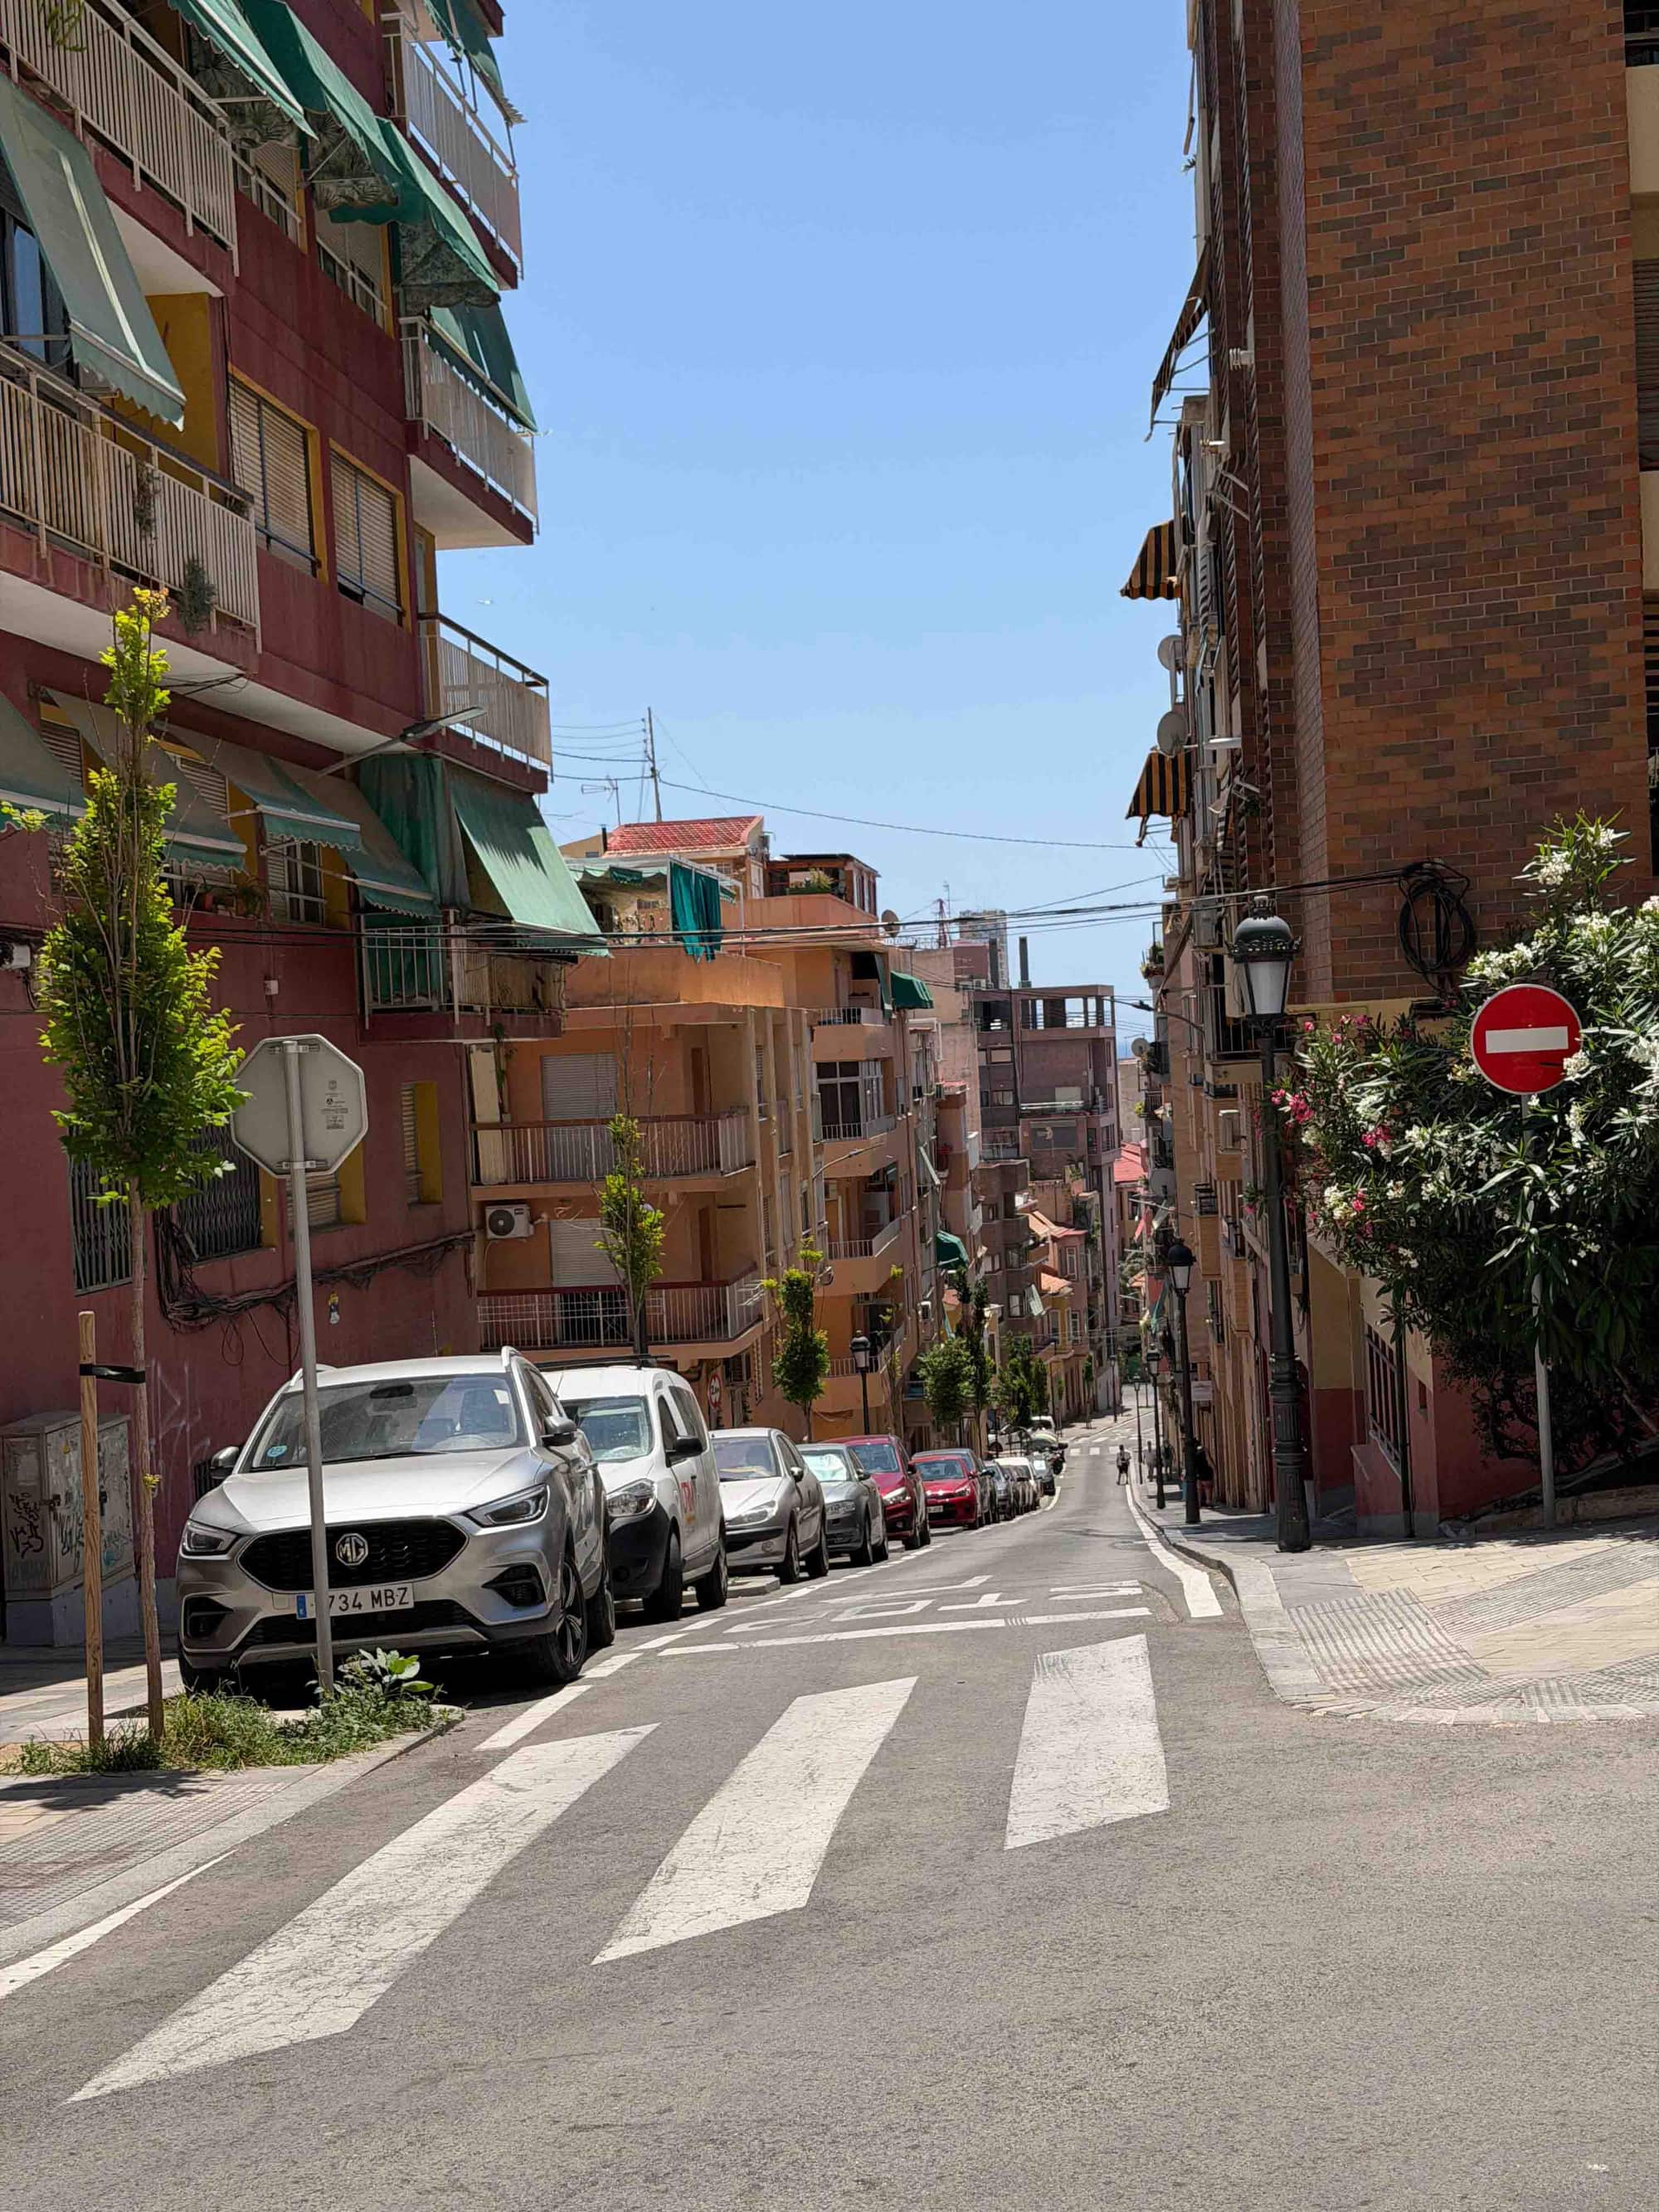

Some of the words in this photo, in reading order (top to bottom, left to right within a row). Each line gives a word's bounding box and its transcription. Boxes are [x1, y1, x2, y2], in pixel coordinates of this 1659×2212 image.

[338, 1536, 365, 1563] MG
[328, 1592, 362, 1612] 734
[370, 1587, 409, 1609] MBZ
